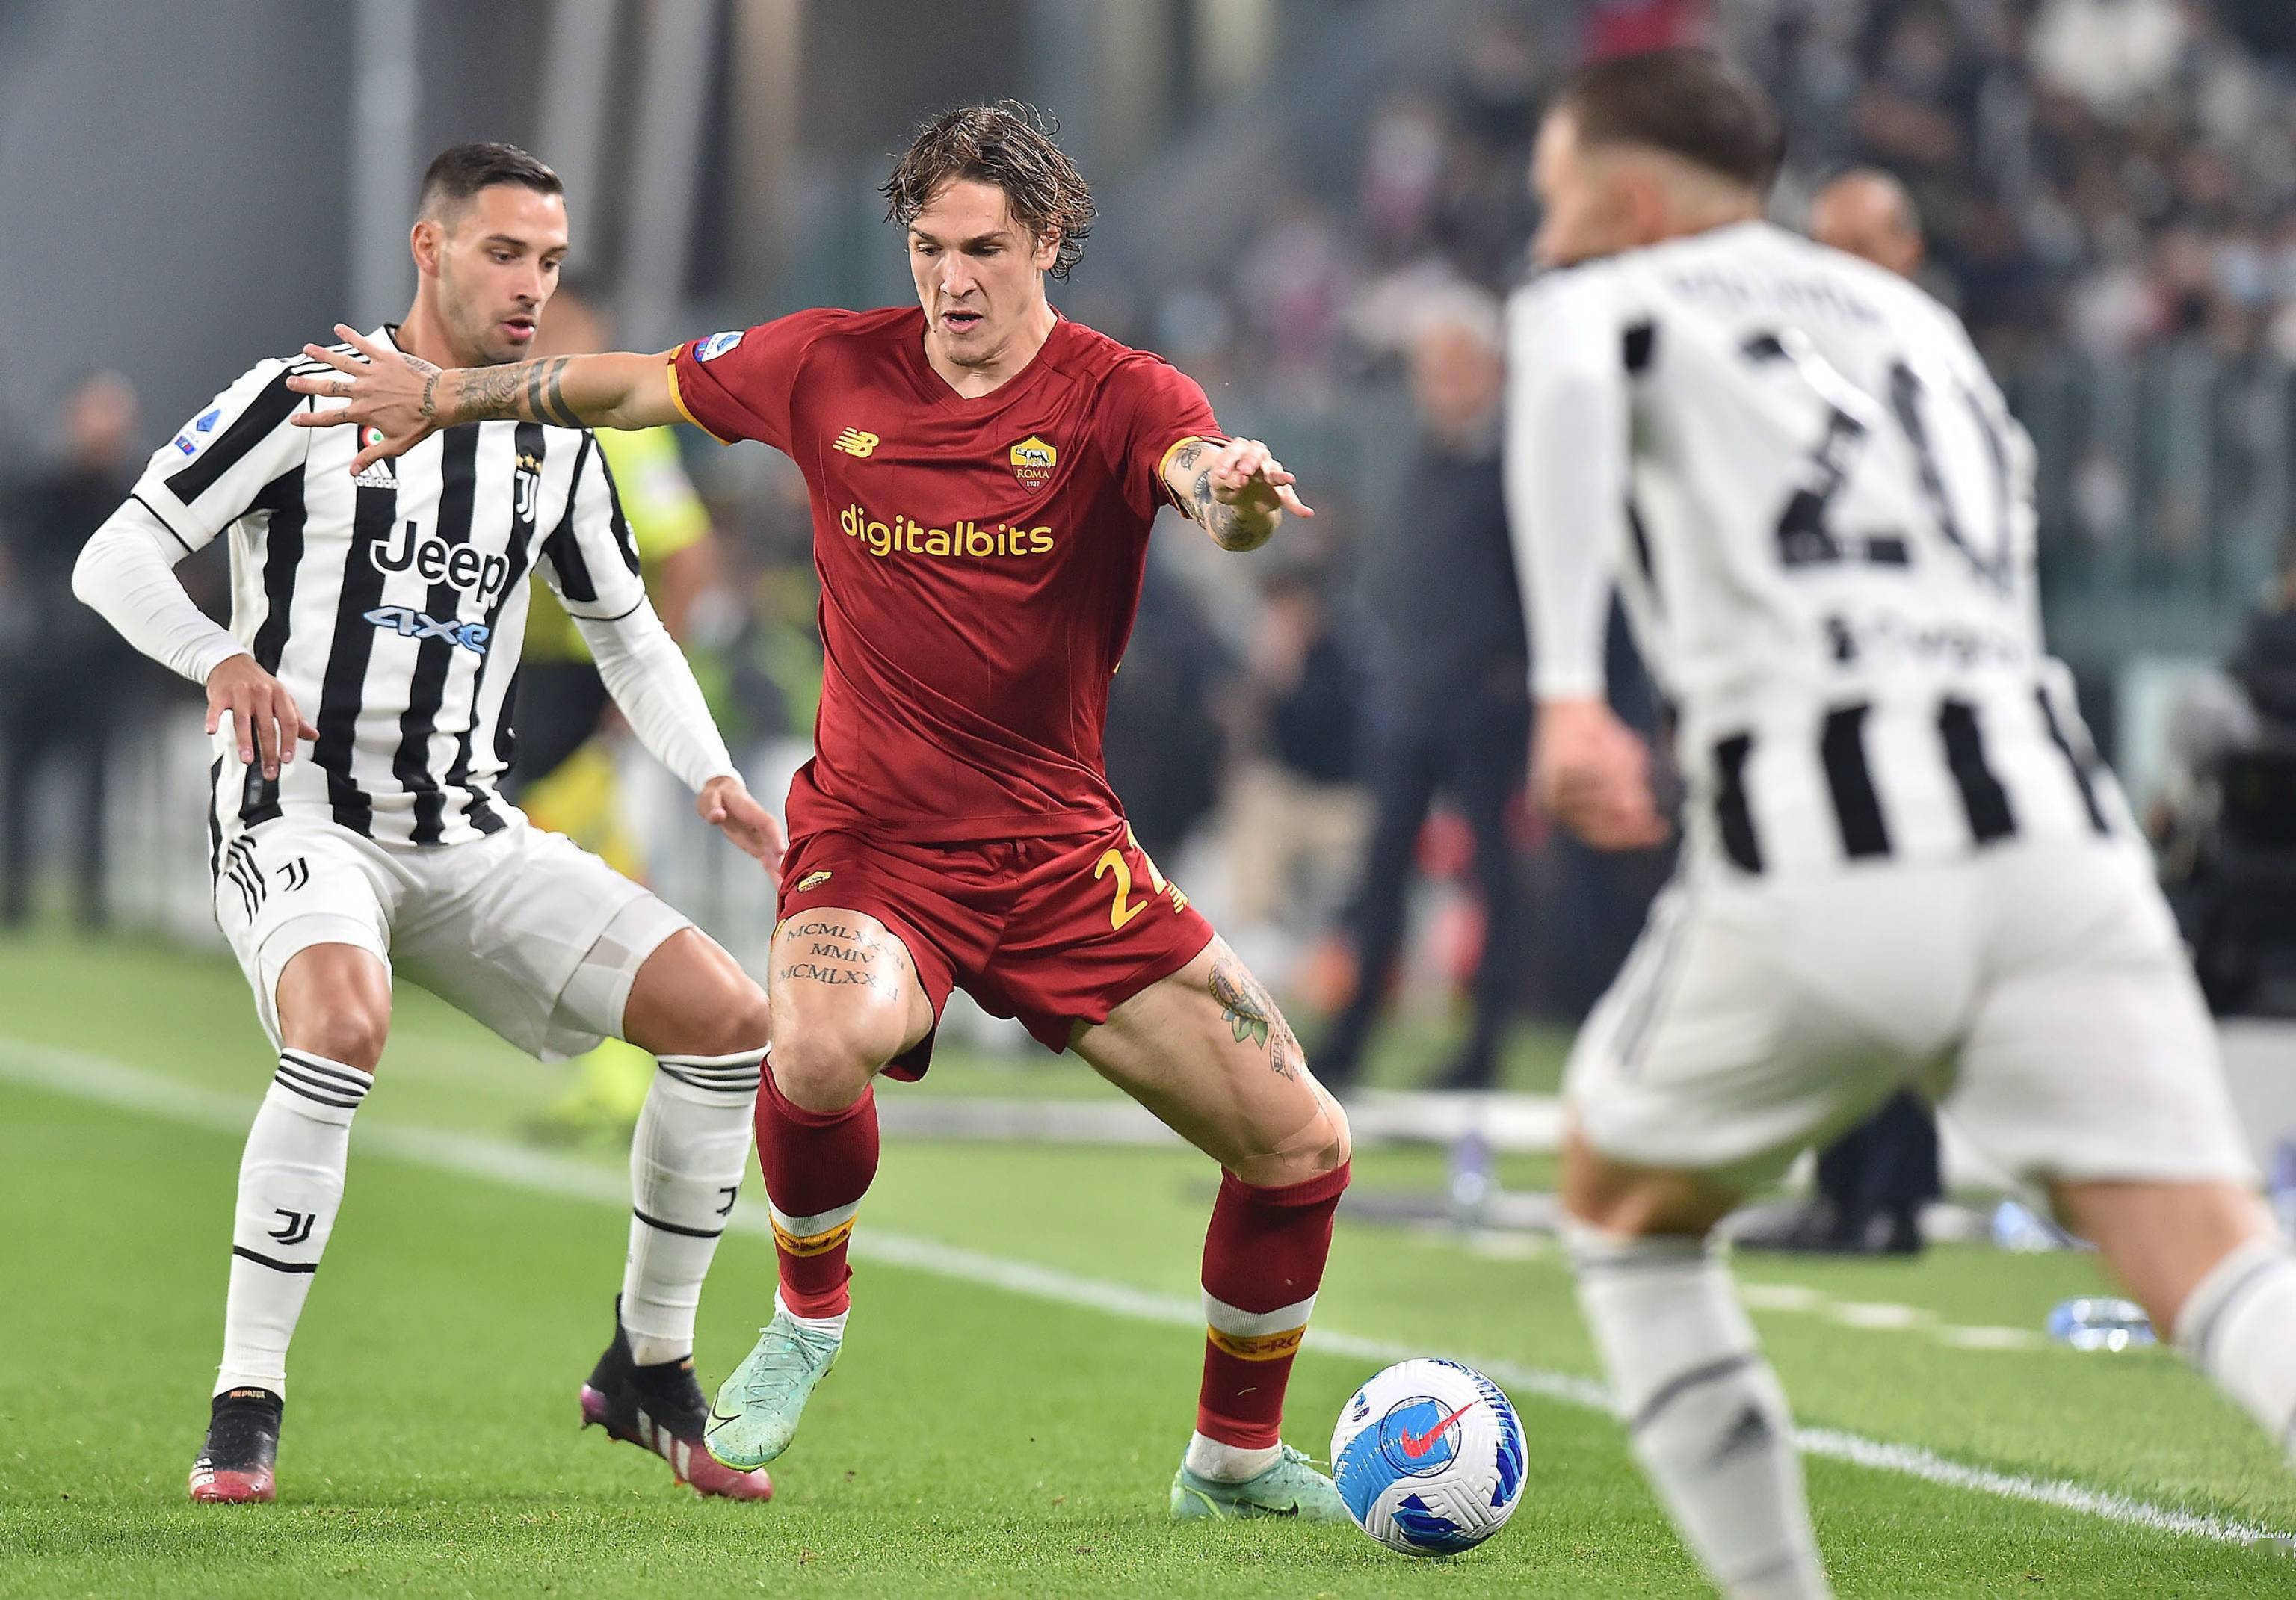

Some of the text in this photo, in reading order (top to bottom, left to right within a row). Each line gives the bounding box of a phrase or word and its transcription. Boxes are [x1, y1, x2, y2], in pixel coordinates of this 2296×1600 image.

[354, 475, 400, 489] adidas
[1016, 469, 1050, 479] ROMA
[840, 503, 1055, 558] digitalbits
[372, 518, 510, 605] Jeep
[809, 942, 875, 964] MMIV
